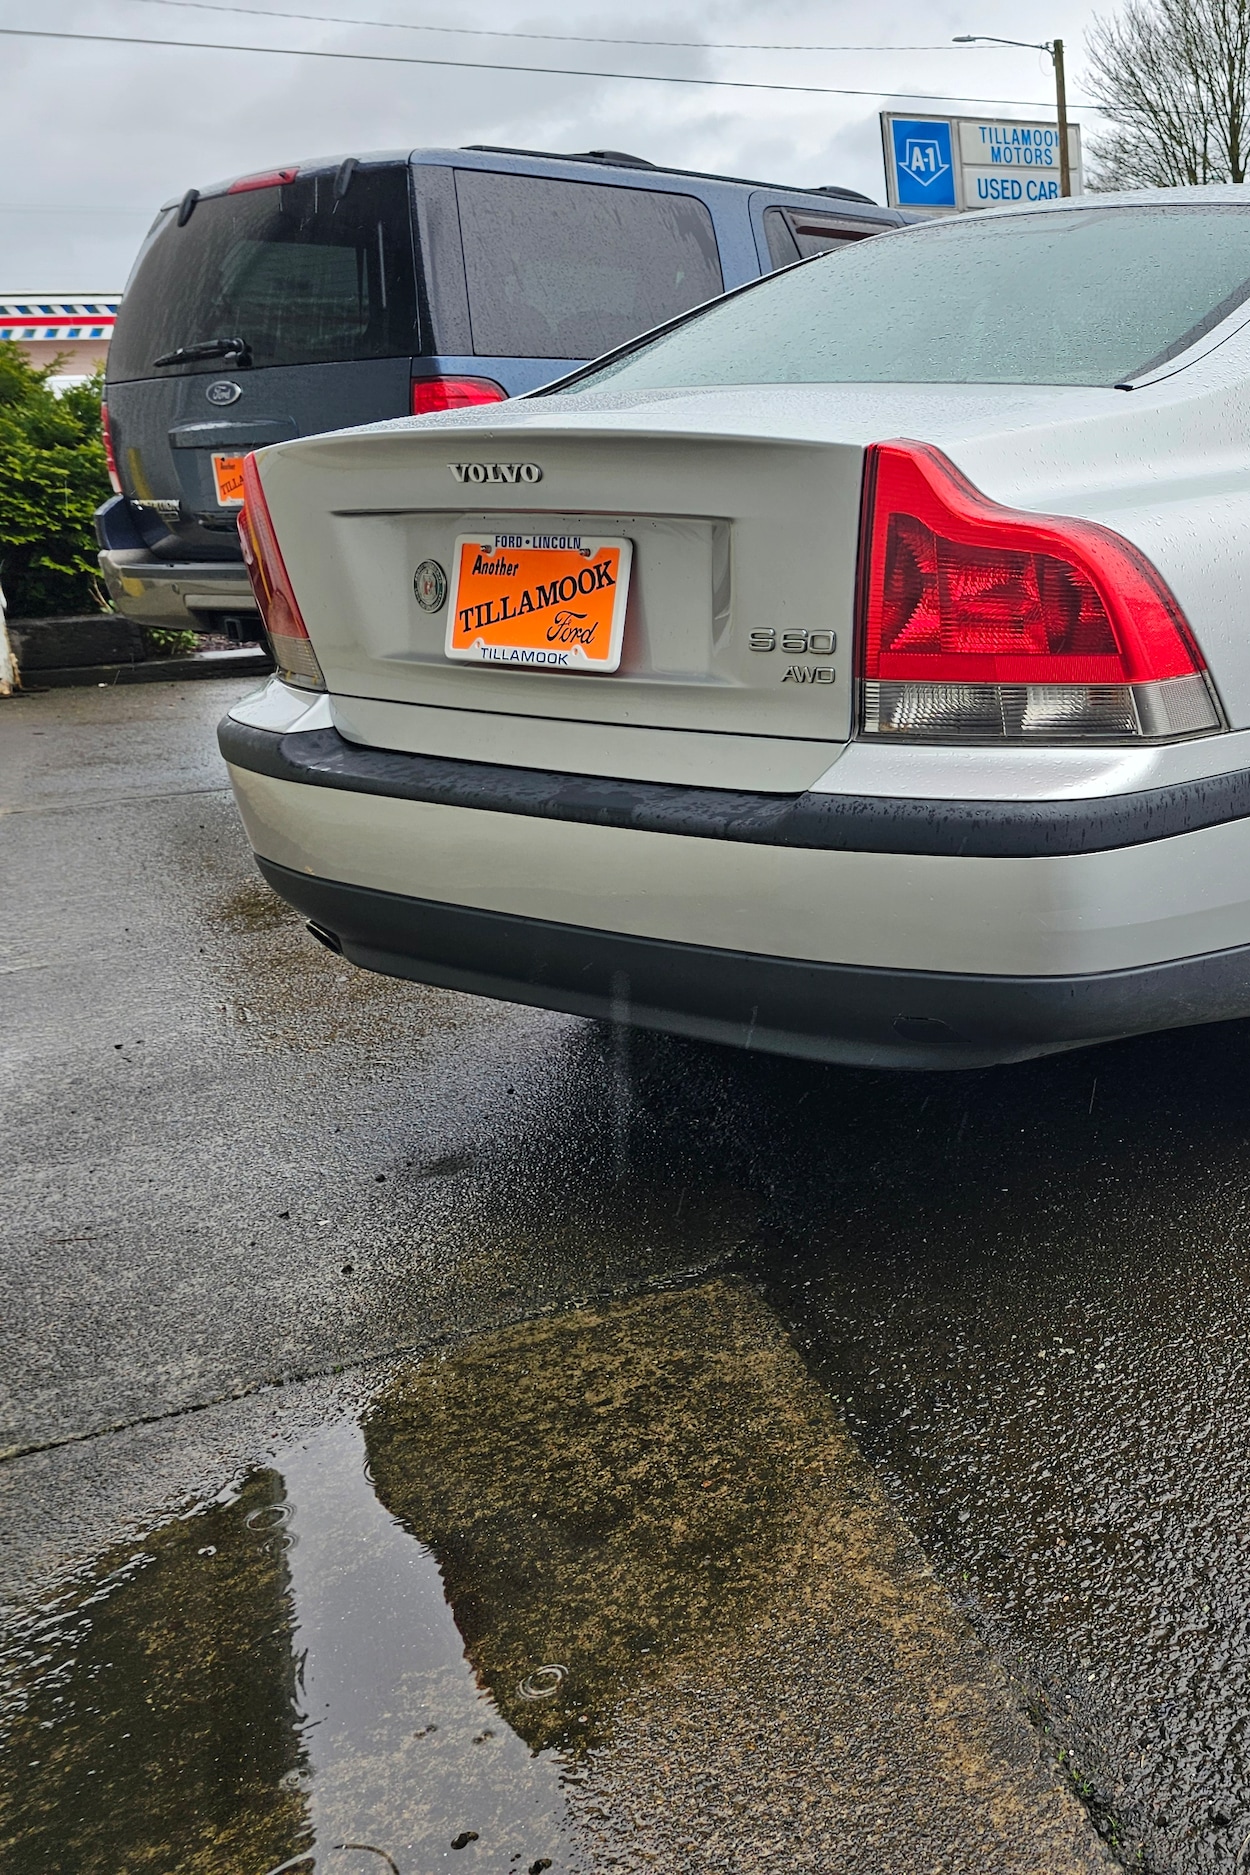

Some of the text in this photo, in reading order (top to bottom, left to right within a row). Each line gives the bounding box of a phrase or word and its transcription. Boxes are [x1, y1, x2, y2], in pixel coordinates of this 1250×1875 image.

[911, 146, 936, 172] A-1
[991, 146, 1053, 166] MOTORS
[977, 178, 1061, 201] USED CAR
[446, 462, 543, 483] VOLVO
[495, 535, 581, 550] FORD LINCOLN
[472, 554, 519, 577] Another
[459, 560, 616, 633] TILLAMOOK
[546, 610, 599, 644] Ford
[481, 647, 569, 666] TILLAMOOK
[780, 665, 836, 684] AWD
